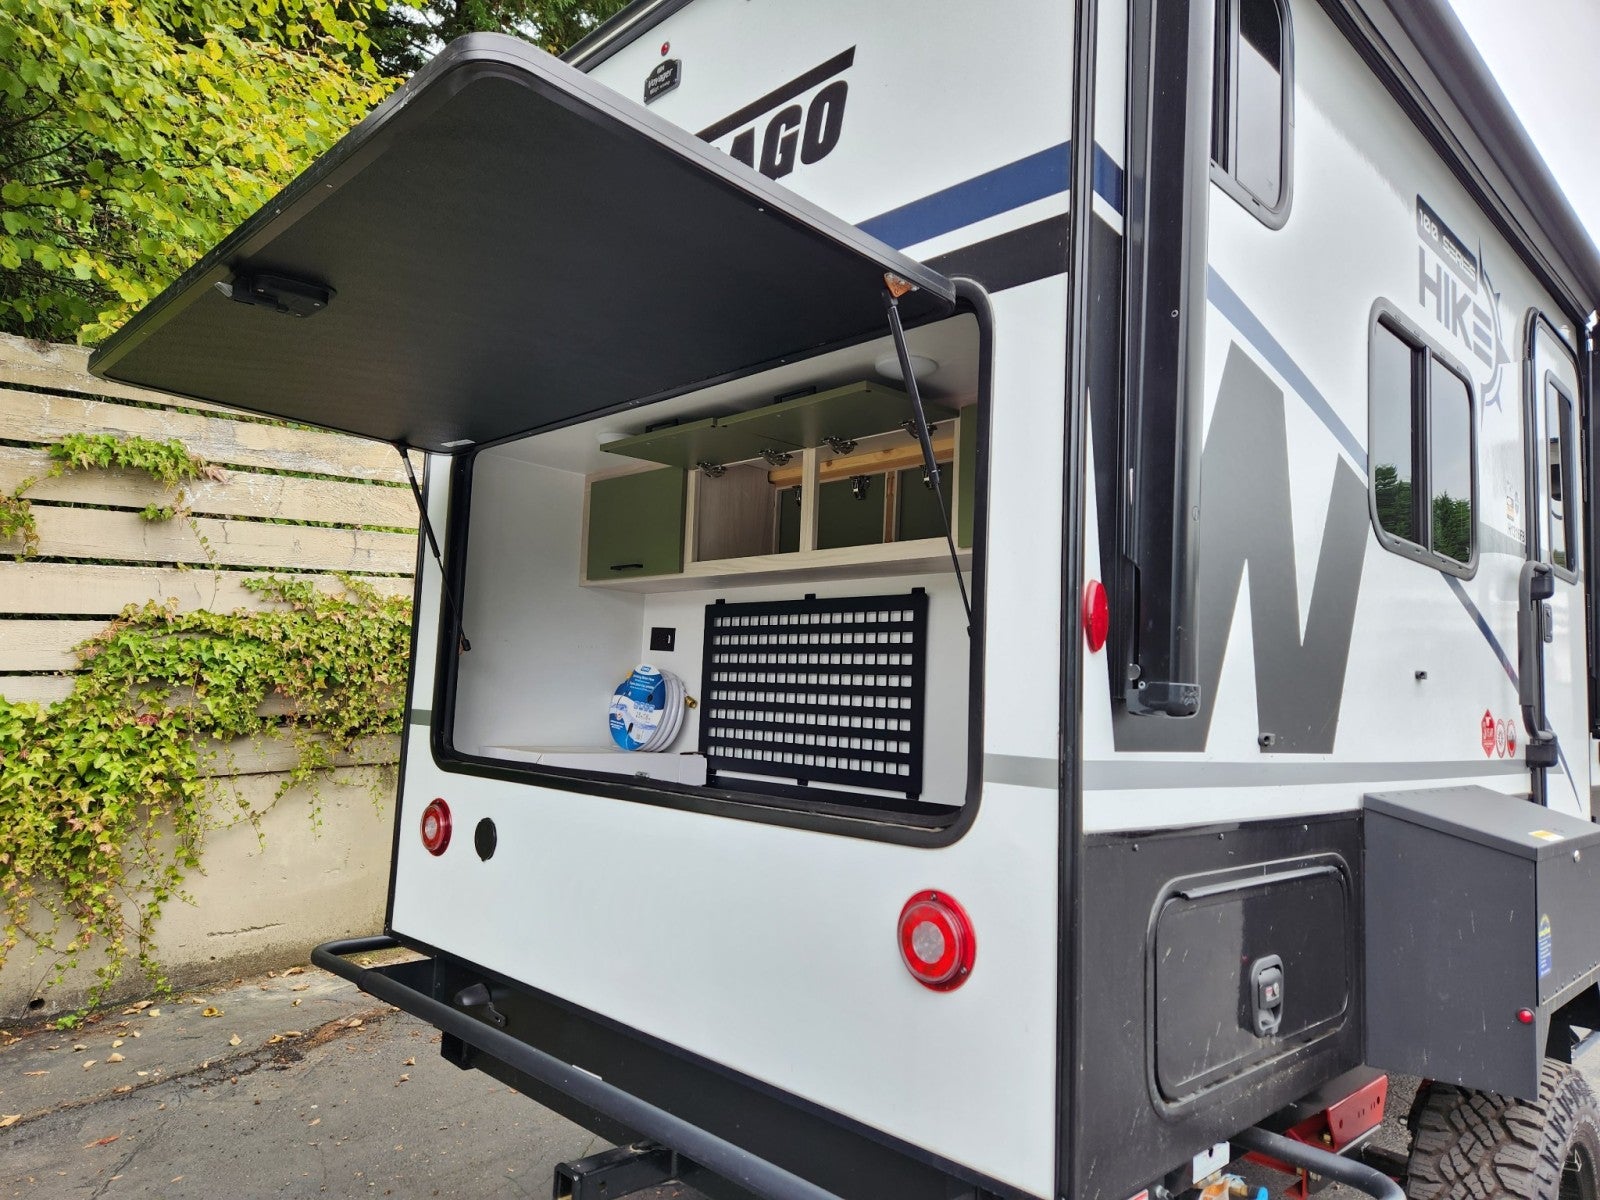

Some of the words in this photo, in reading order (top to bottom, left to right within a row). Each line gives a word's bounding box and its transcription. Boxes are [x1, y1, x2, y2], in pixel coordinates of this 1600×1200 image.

[1418, 208, 1439, 242] 100
[1442, 235, 1476, 281] SERIES
[1418, 244, 1493, 370] HIKE
